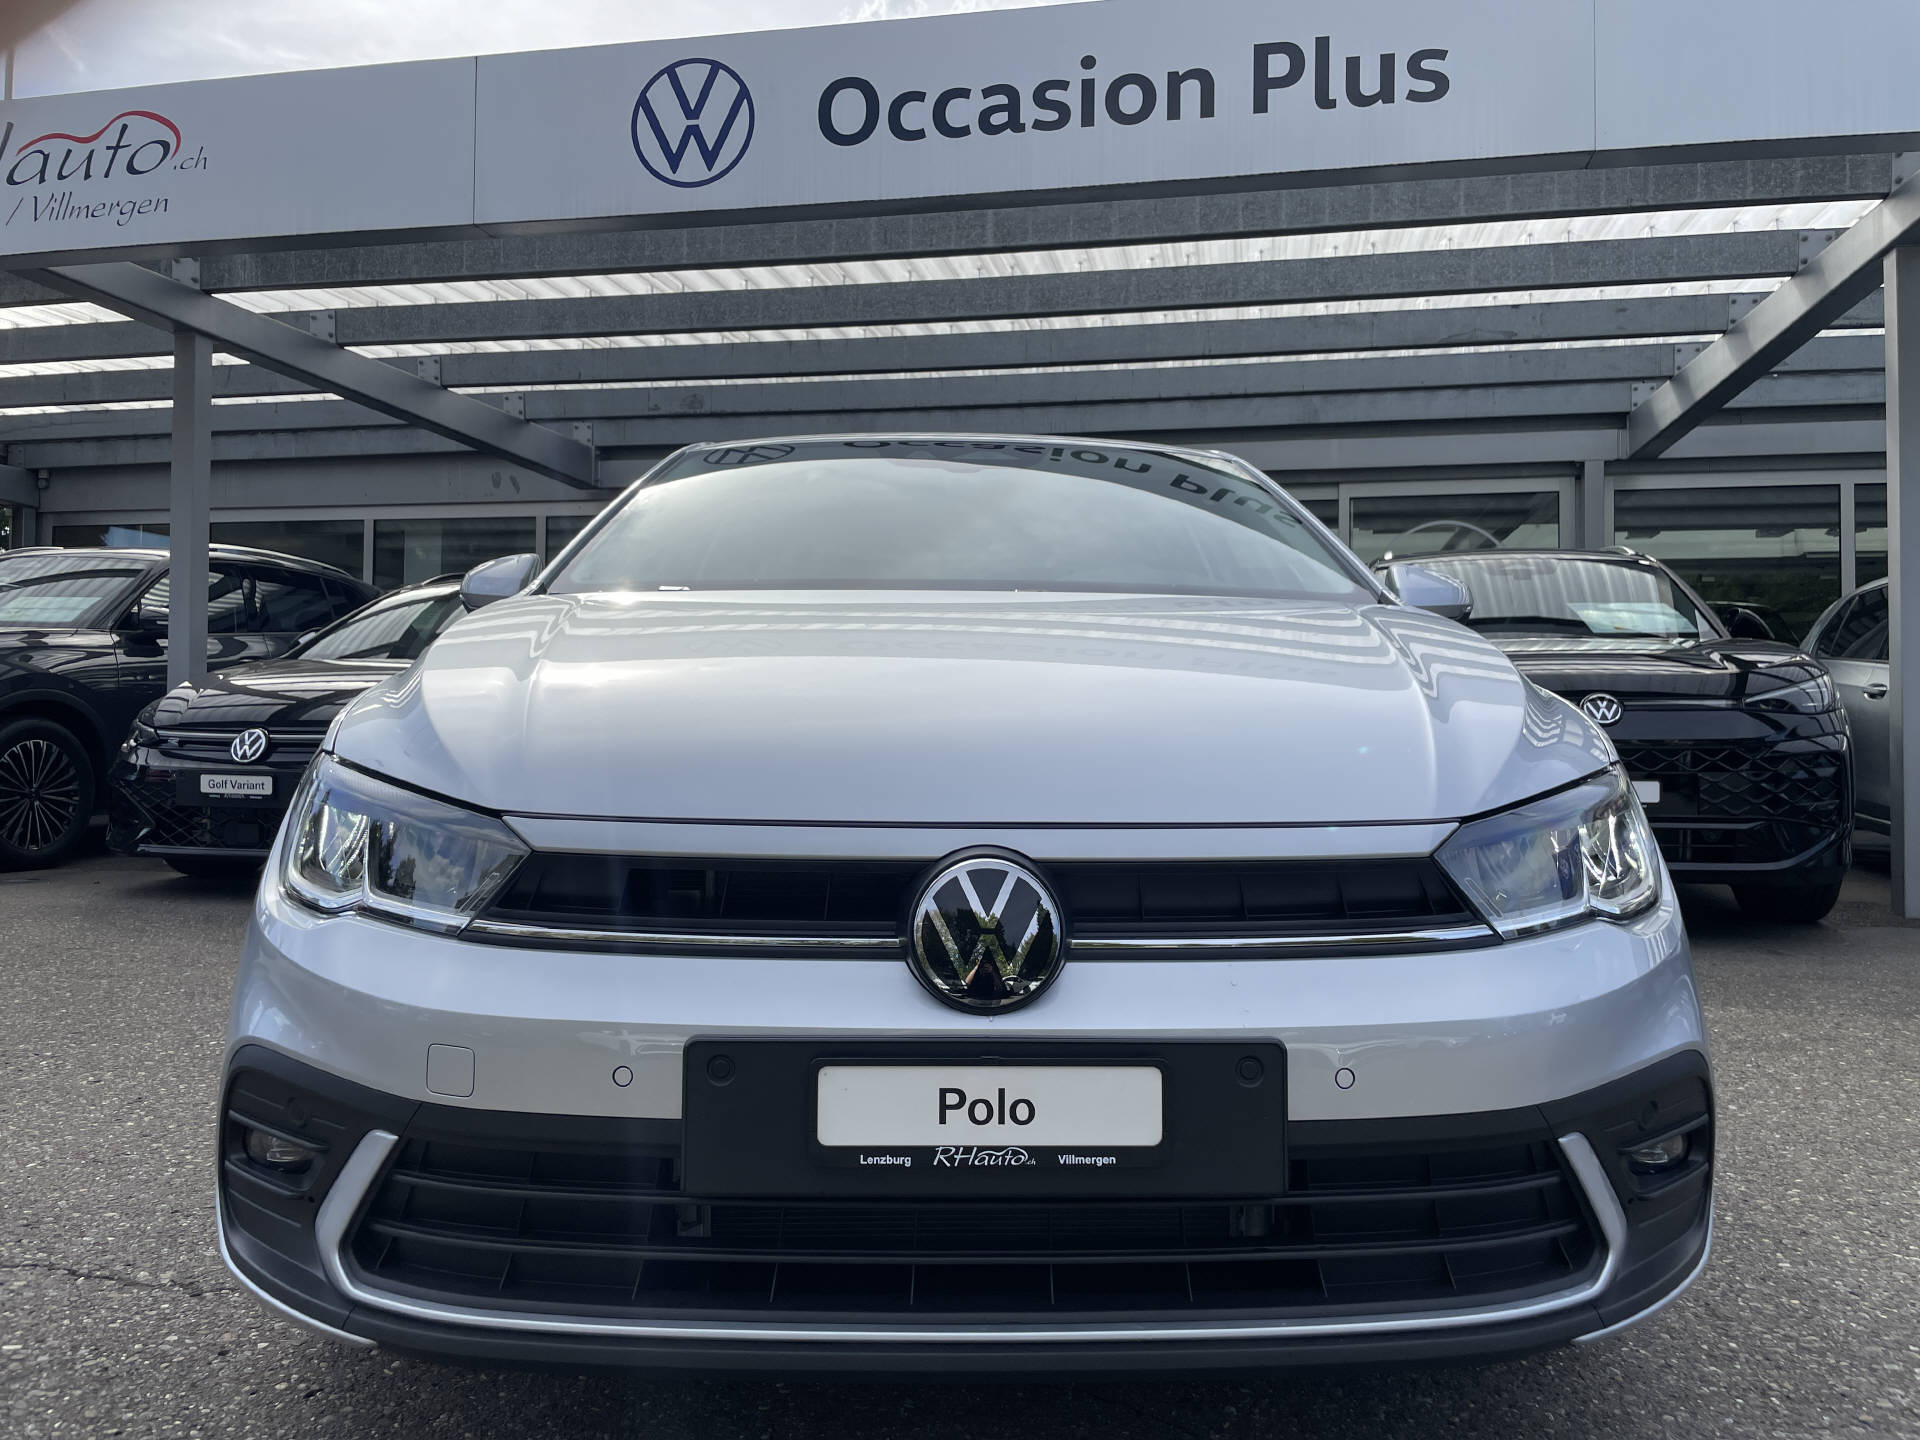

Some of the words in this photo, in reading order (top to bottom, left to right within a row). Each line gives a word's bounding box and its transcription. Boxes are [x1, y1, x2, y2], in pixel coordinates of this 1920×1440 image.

[818, 54, 1216, 147] Occasion
[1252, 35, 1450, 114] Plus
[631, 57, 756, 188] VW
[207, 778, 228, 790] Golf
[230, 779, 265, 791] Variant
[938, 1087, 1036, 1126] Polo
[860, 1154, 912, 1167] Lenzburg
[1058, 1154, 1117, 1167] Villmergen
